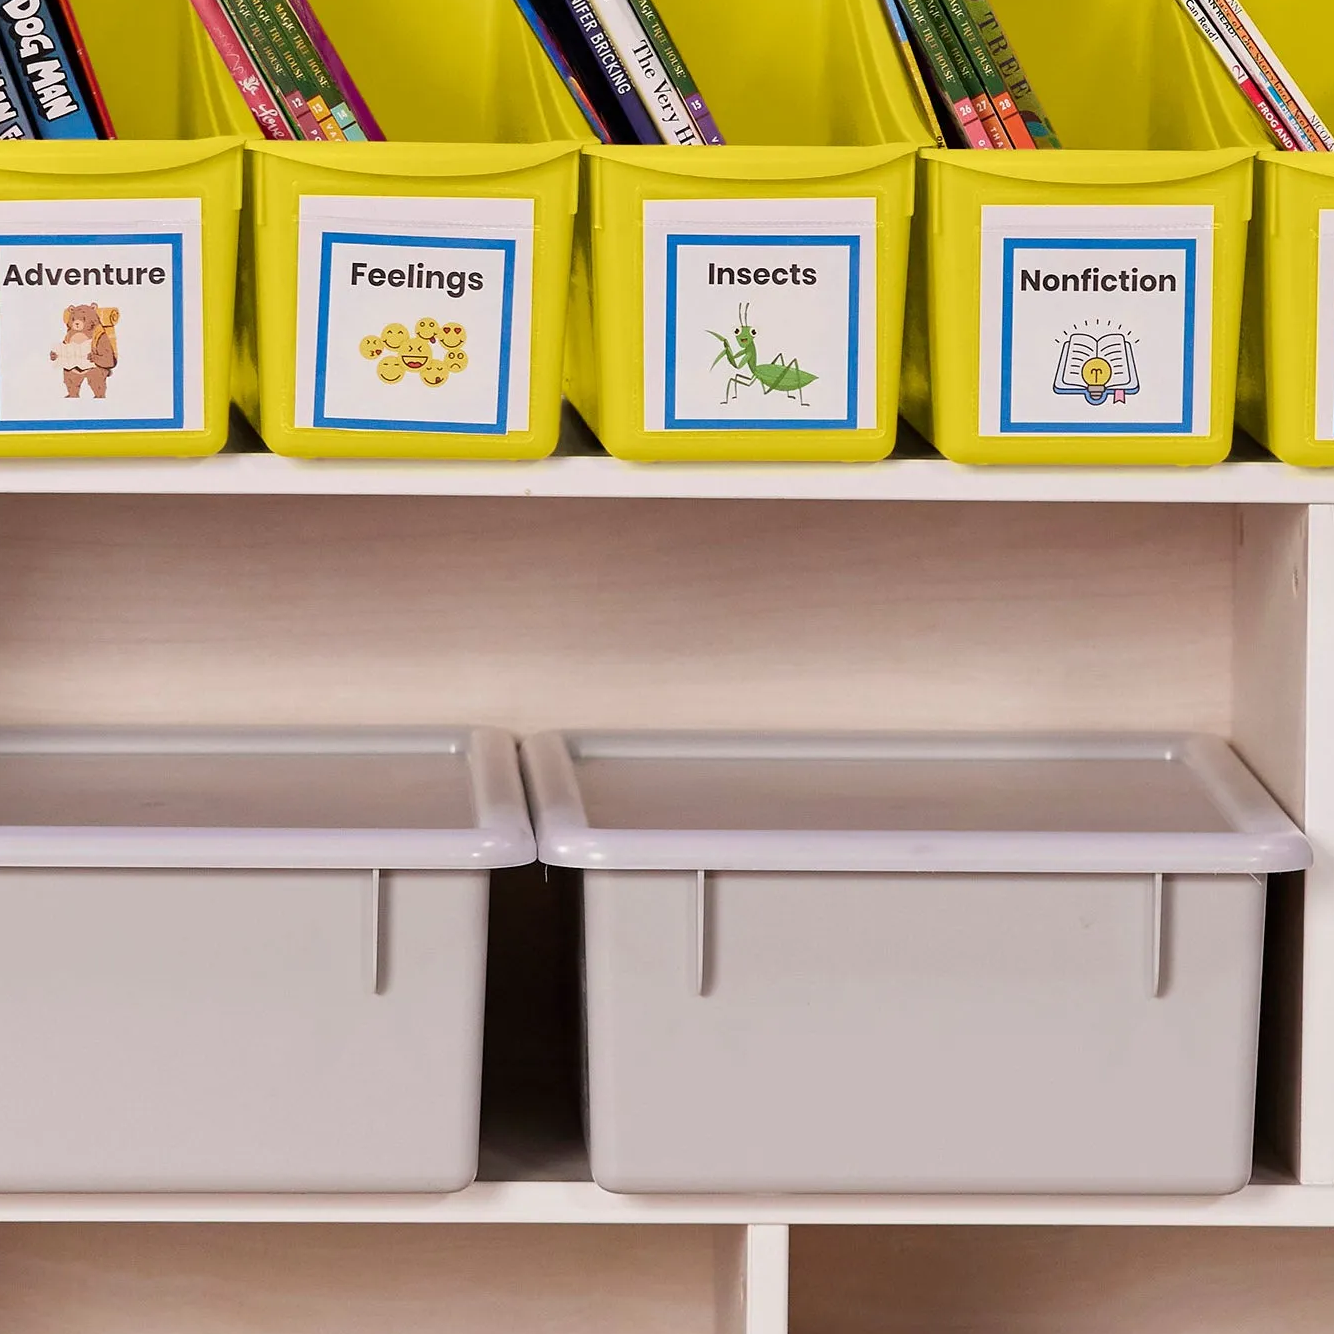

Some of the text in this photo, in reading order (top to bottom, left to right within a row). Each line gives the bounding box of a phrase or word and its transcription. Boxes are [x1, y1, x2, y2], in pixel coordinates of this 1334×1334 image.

[249, 22, 265, 44] TREE
[275, 3, 297, 33] MAGIC
[293, 34, 310, 57] TREE
[651, 20, 667, 46] TREE
[961, 21, 977, 44] TREE
[1185, 0, 1199, 18] Can
[1198, 17, 1220, 43] Read!
[1216, 9, 1237, 38] READ!
[1232, 21, 1243, 30] of
[269, 26, 285, 48] TREE
[923, 27, 938, 50] TREE
[938, 24, 954, 44] TREE
[590, 33, 631, 96] BRICKING
[979, 11, 1032, 99] TREE
[1232, 64, 1245, 79] 2
[27, 58, 79, 121] MAN
[631, 38, 696, 145] The Very H
[292, 97, 303, 108] 12
[691, 99, 702, 110] 15
[960, 105, 972, 116] 26
[977, 102, 987, 112] 27
[999, 99, 1012, 110] 28
[1257, 101, 1294, 149] FROG AND
[2, 262, 166, 286] Adventure
[351, 262, 484, 298] Feelings
[708, 262, 817, 286] Insects
[1020, 267, 1176, 293] Nonfiction
